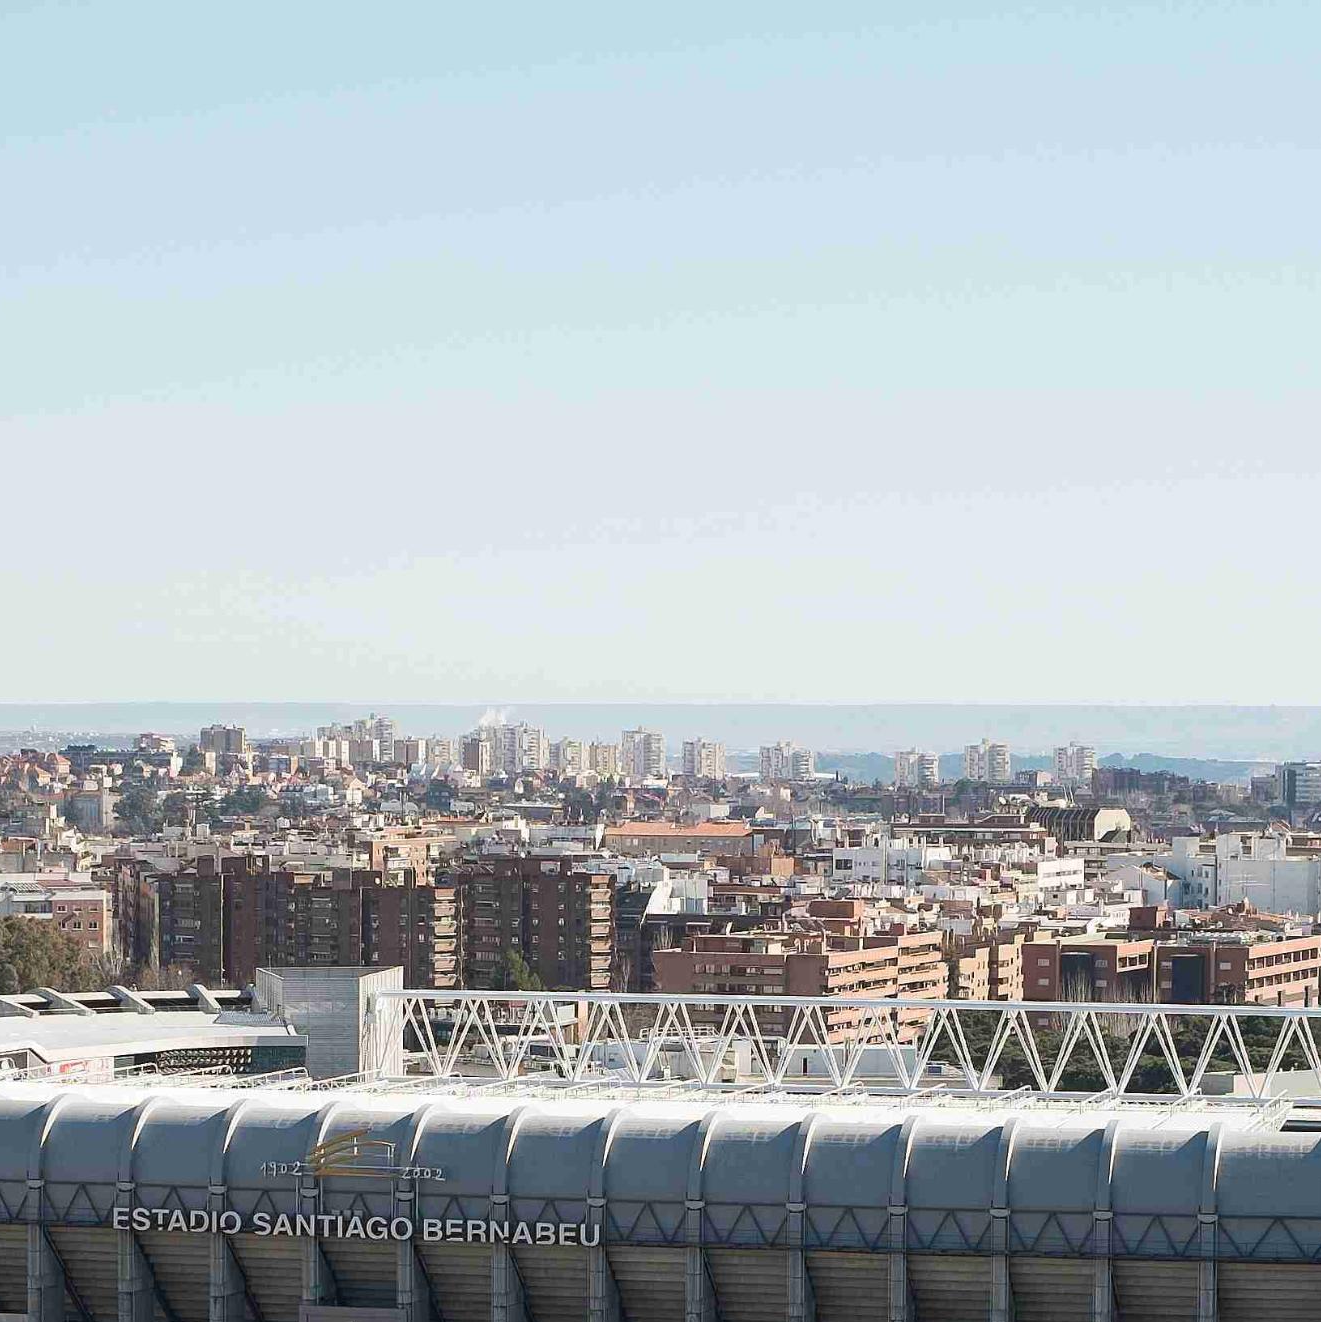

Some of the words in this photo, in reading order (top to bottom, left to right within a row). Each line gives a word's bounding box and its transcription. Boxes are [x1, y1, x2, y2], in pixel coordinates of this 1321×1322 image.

[260, 1161, 303, 1177] 1902
[401, 1167, 446, 1181] 2002
[112, 1207, 242, 1235] ESTADIO
[252, 1211, 413, 1241] SANTIAGO
[423, 1217, 600, 1248] BERNABEU
